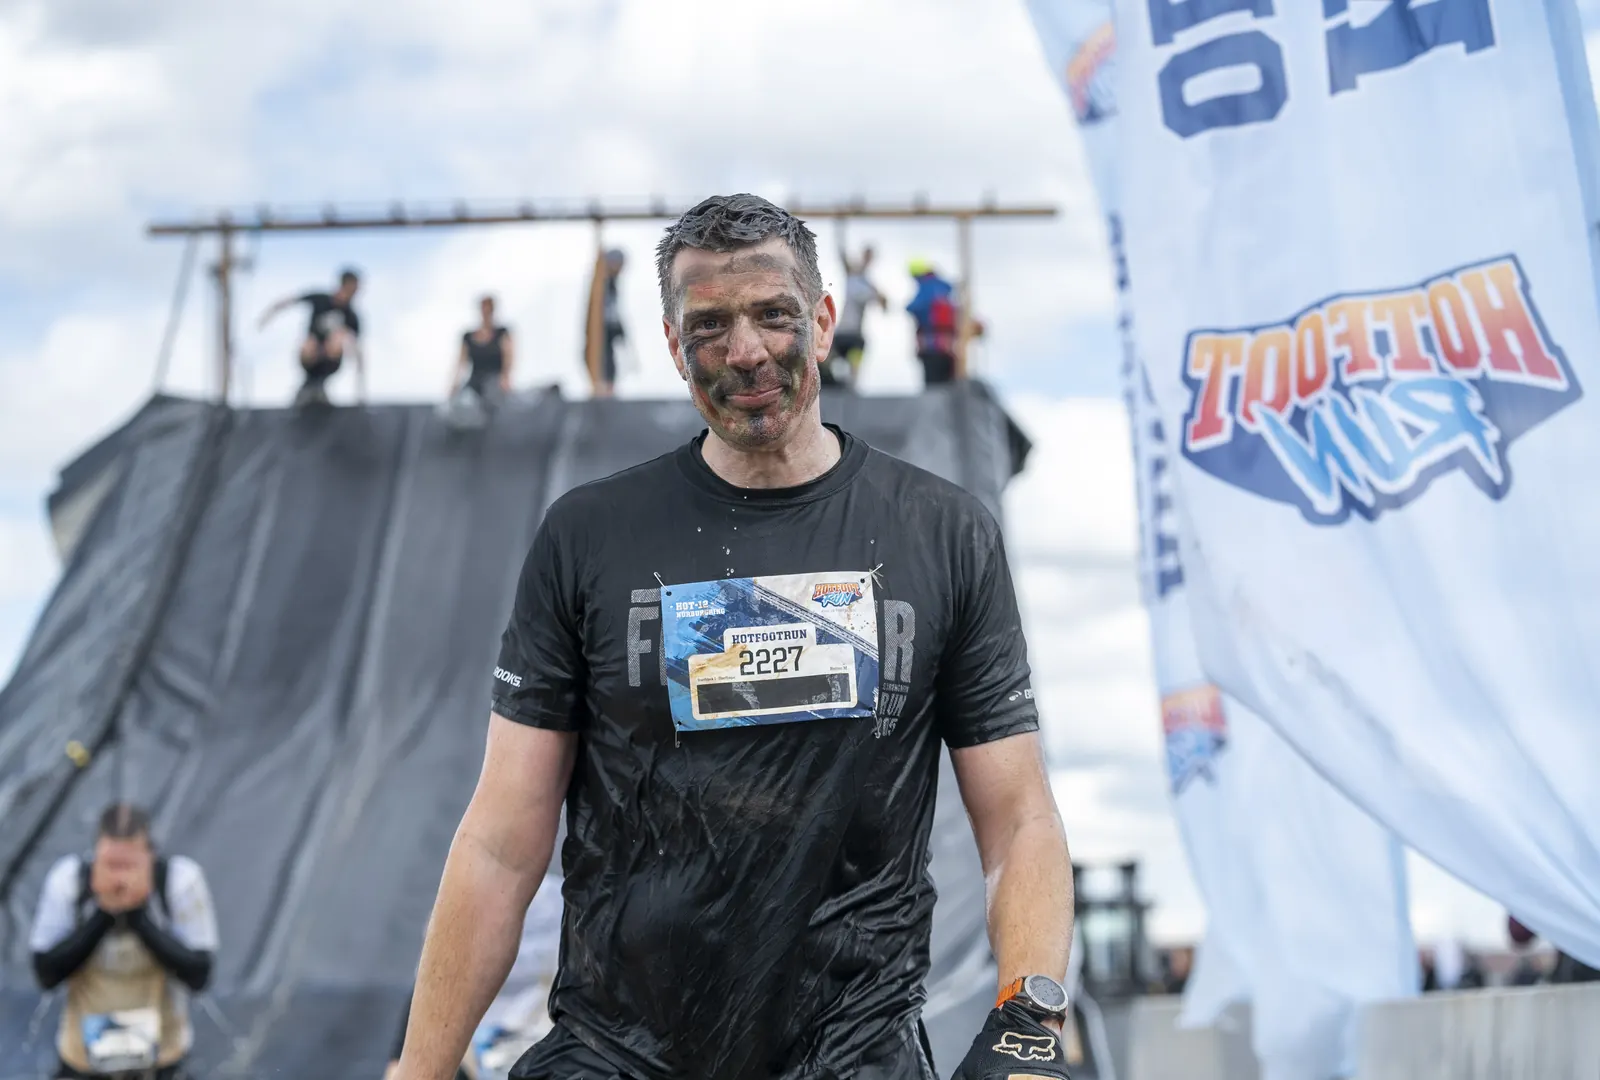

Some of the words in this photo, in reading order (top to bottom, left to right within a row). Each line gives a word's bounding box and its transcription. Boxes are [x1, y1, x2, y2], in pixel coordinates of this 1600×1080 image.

[732, 629, 808, 644] HOTFOOTRUN
[739, 645, 804, 676] 2227
[879, 691, 907, 717] RUN
